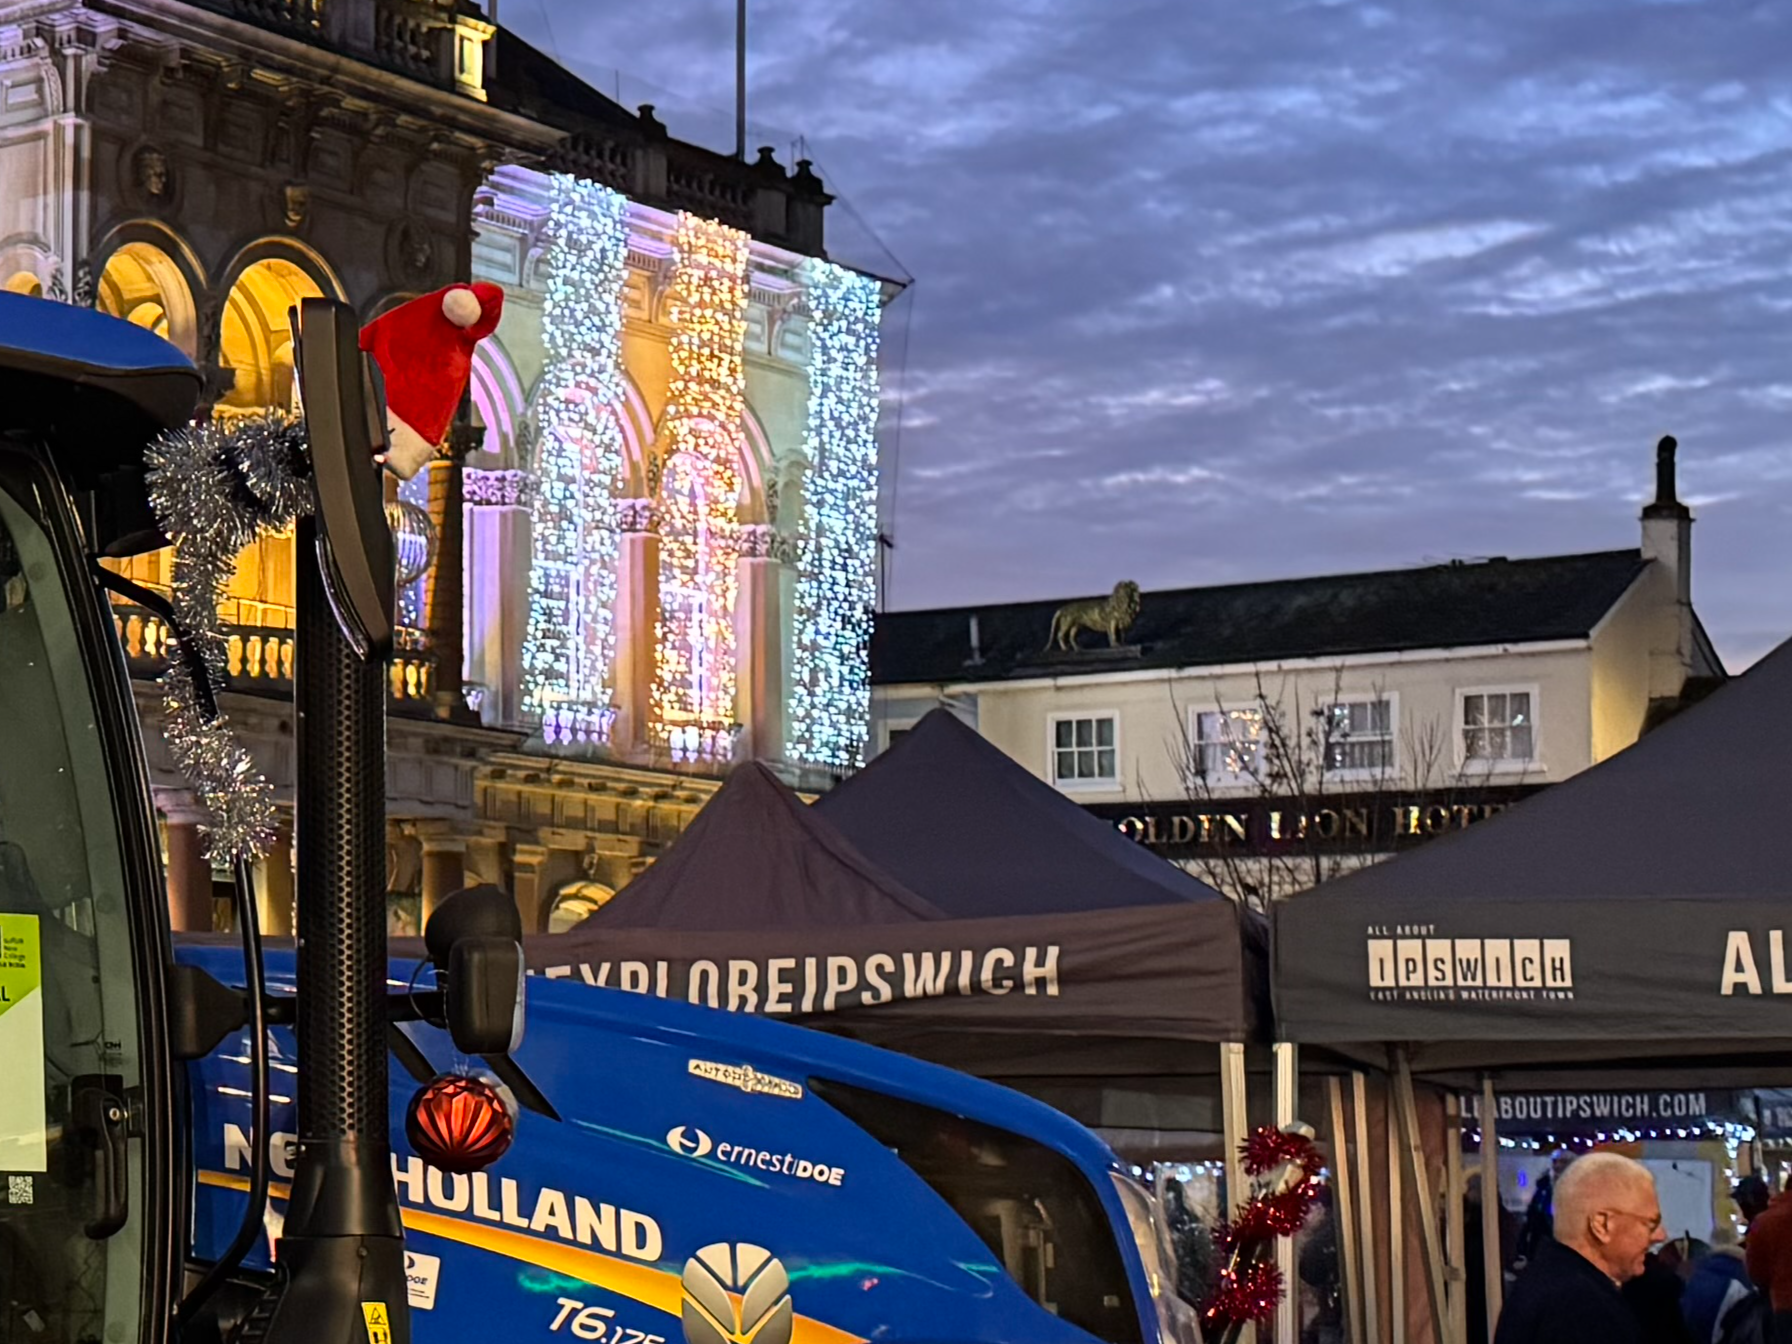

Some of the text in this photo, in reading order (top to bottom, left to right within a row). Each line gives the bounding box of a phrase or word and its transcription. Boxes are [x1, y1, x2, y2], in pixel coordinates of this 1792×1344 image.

[1367, 924, 1435, 936] ALL ABOUT
[1379, 956, 1566, 983] IPSWICH
[1720, 929, 1792, 996] AL
[1460, 1093, 1707, 1120] LLBOUTIPSWICH.COM
[391, 1152, 663, 1262] HOLLAND
